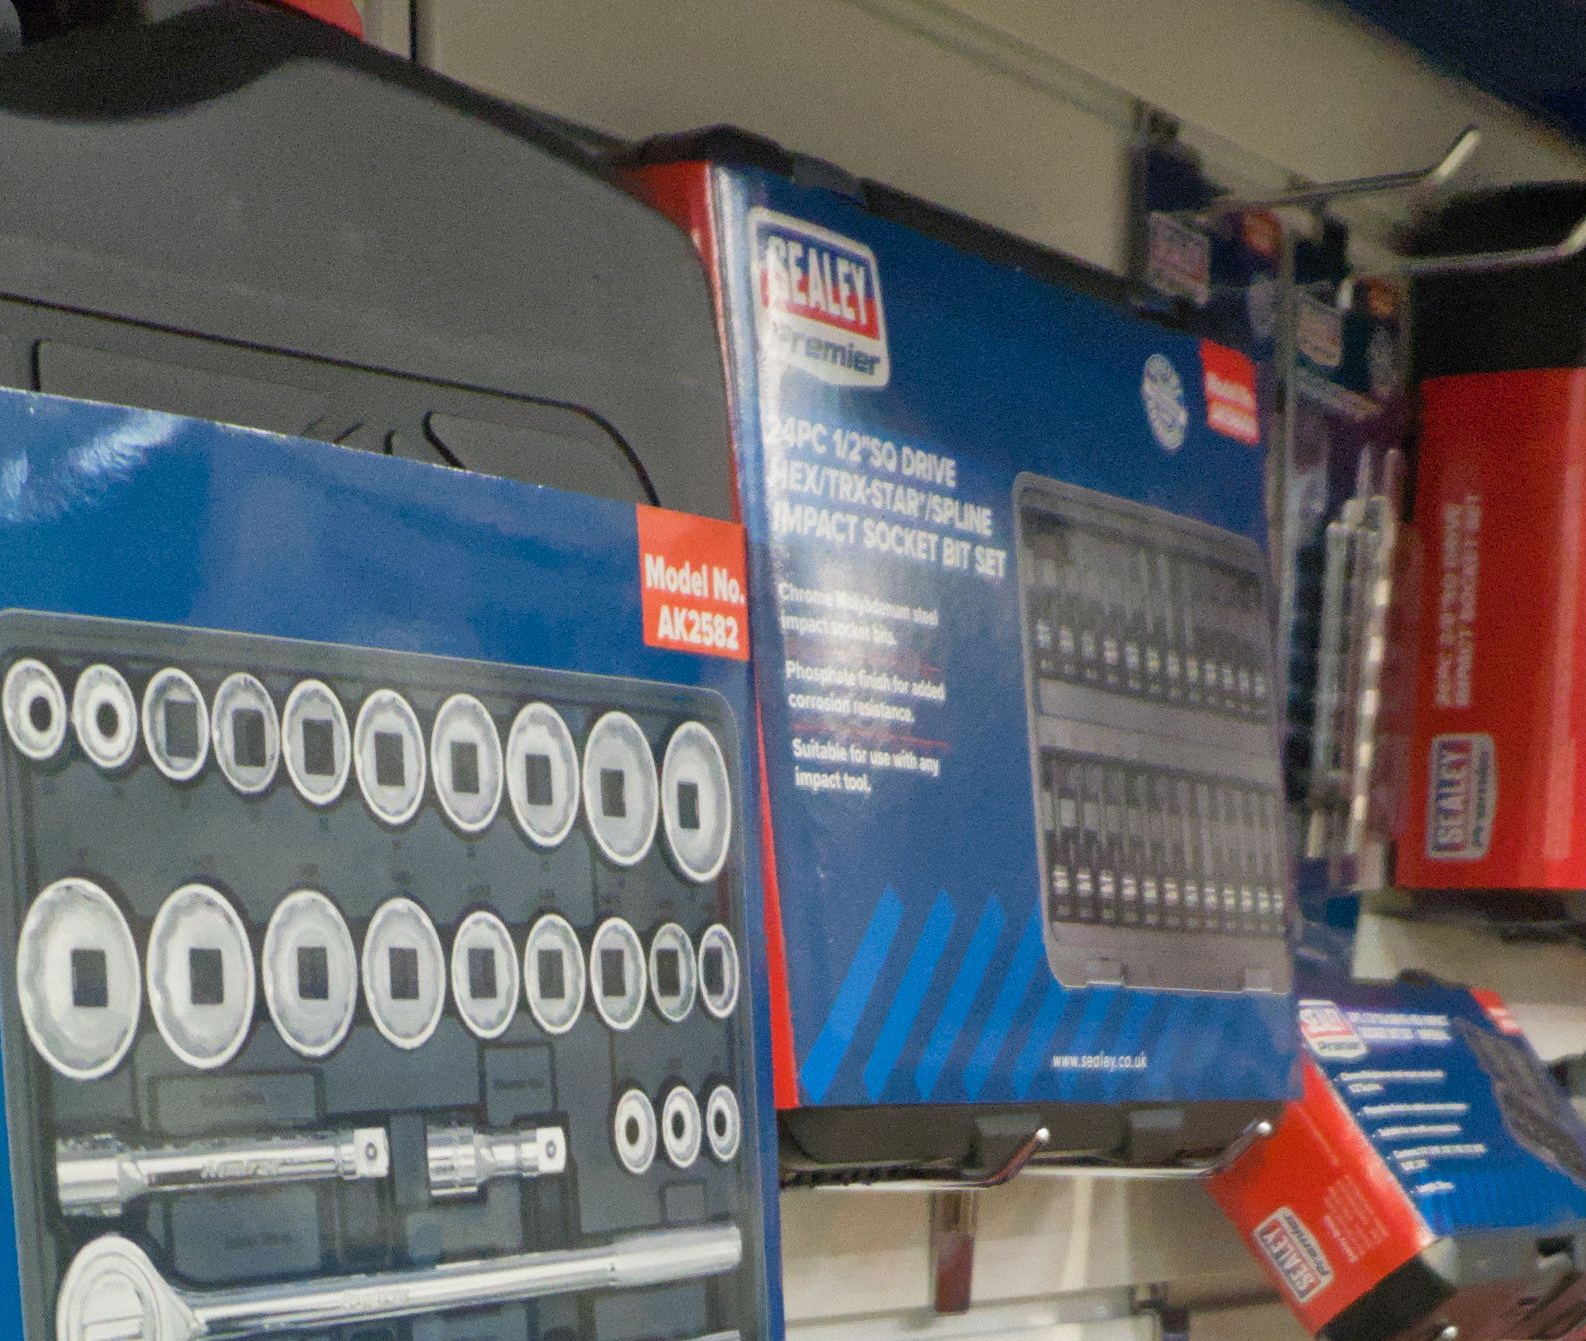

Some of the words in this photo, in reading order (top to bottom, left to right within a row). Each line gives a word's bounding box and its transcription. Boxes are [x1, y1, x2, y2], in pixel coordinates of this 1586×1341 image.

[766, 235, 869, 328] SEALEY
[901, 447, 957, 487] DRIVE
[864, 517, 939, 561] SOCKET
[942, 537, 973, 569] BIT
[975, 545, 1007, 578] SET
[644, 553, 708, 597] Model
[713, 566, 745, 604] No.
[657, 605, 738, 650] AK2582
[1052, 1050, 1147, 1072] www.sealey.co.uk
[1263, 1226, 1318, 1292] SEALEY
